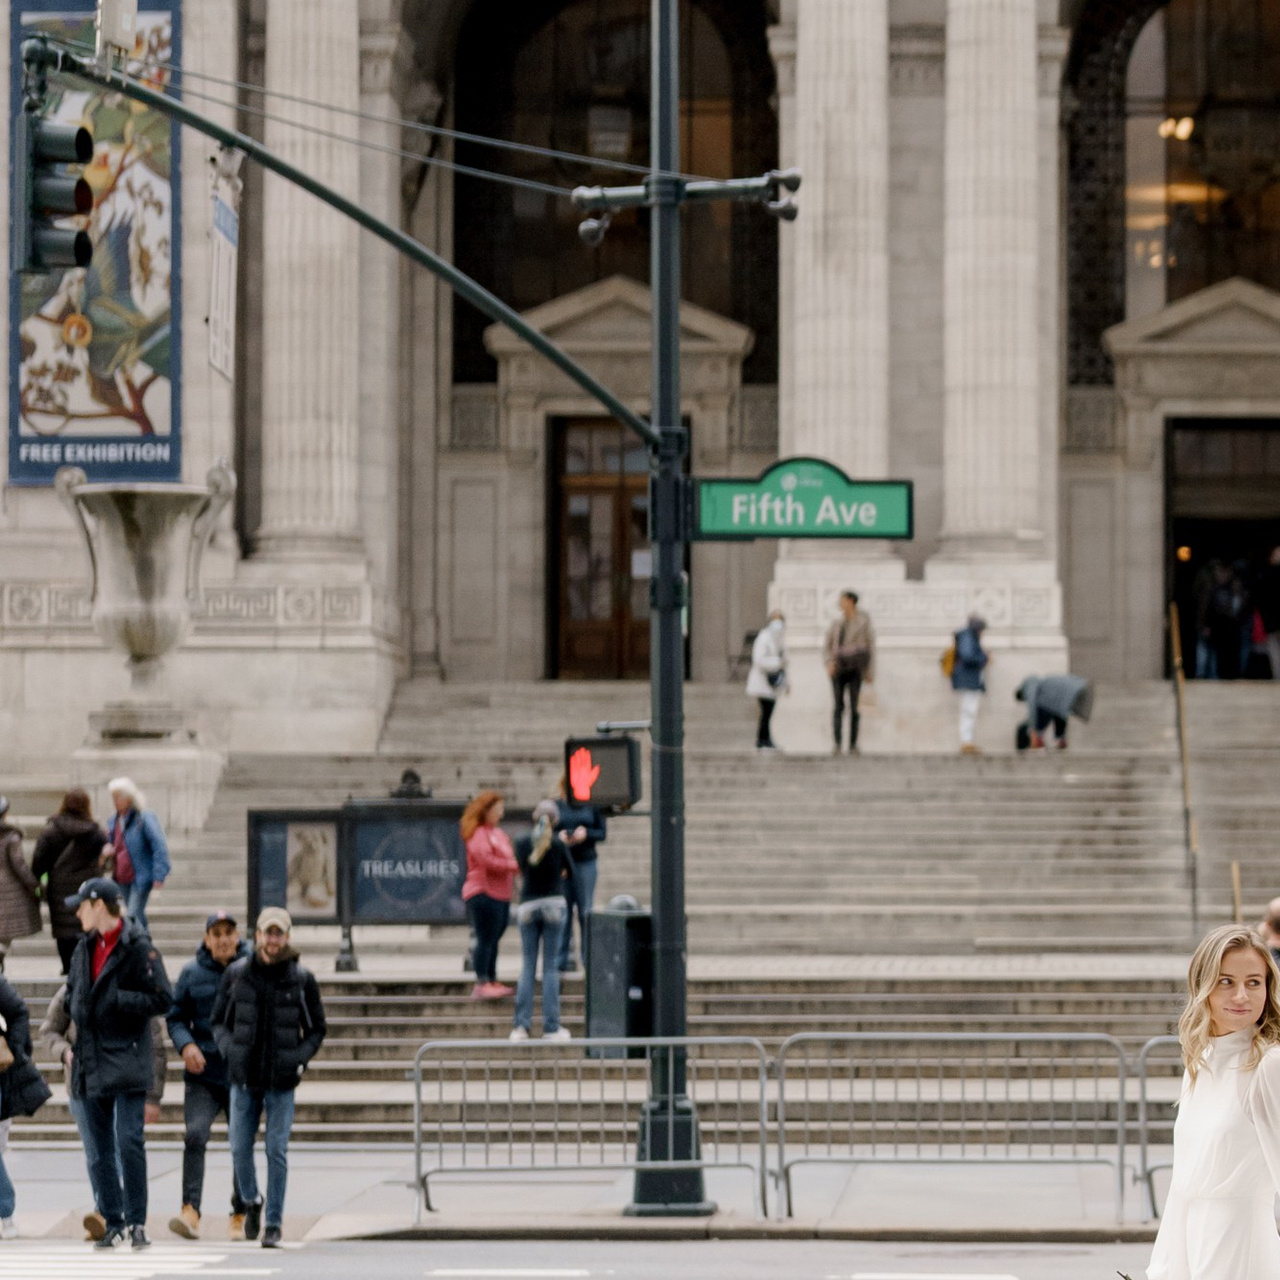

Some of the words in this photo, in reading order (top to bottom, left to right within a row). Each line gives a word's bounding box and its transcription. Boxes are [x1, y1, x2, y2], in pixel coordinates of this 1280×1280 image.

[19, 443, 62, 463] FREE
[64, 443, 171, 463] EXHIBITION
[732, 493, 805, 525] Fifth
[815, 496, 877, 526] Ave
[361, 859, 460, 877] TREASURES
